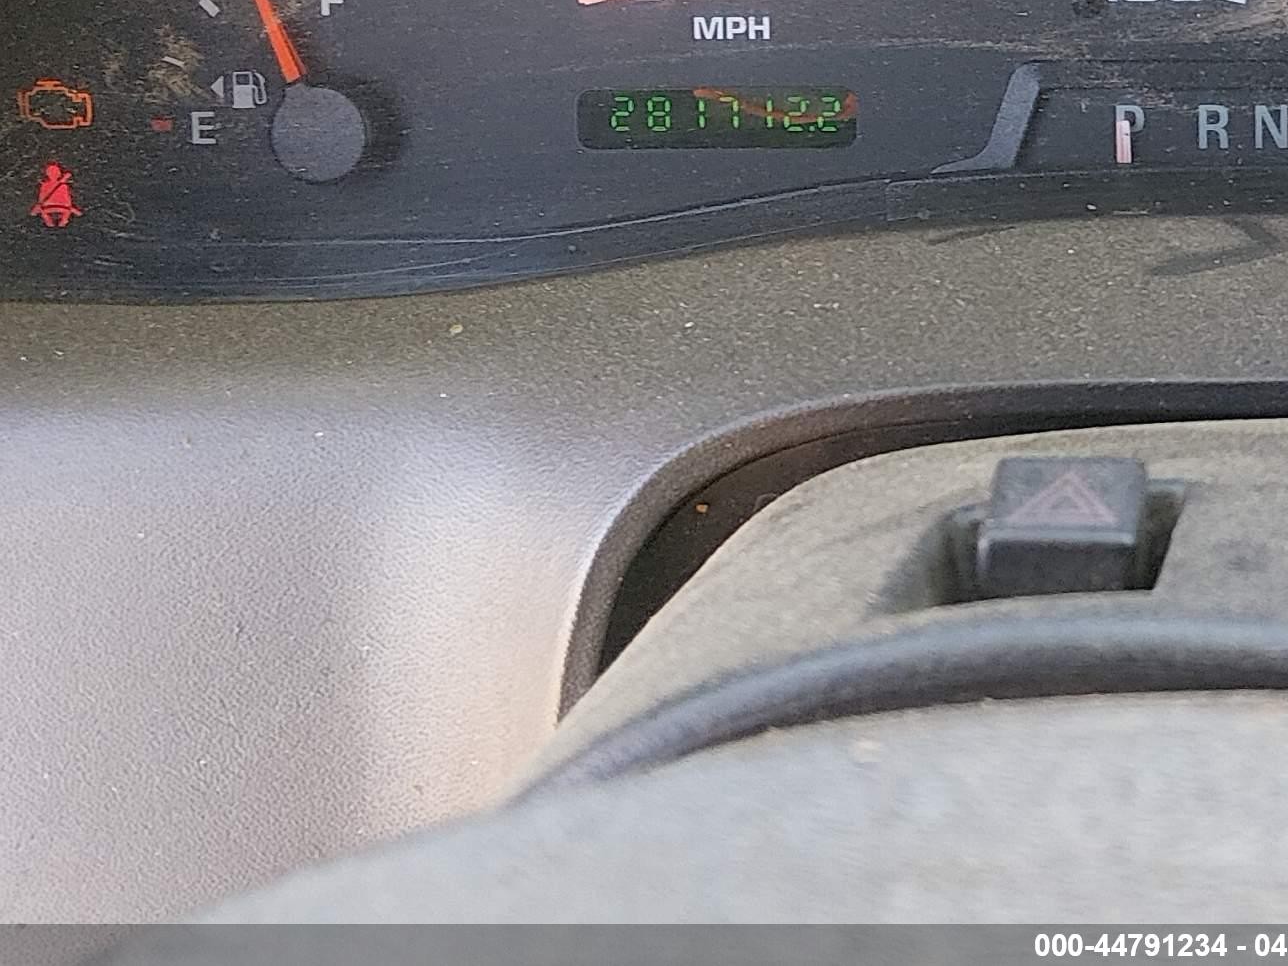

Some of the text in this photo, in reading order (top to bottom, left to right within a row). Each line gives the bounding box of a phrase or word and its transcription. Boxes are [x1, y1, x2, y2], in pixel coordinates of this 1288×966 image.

[693, 16, 771, 40] MPH
[190, 111, 217, 145] E
[1197, 104, 1229, 149] R
[1254, 104, 1288, 149] N
